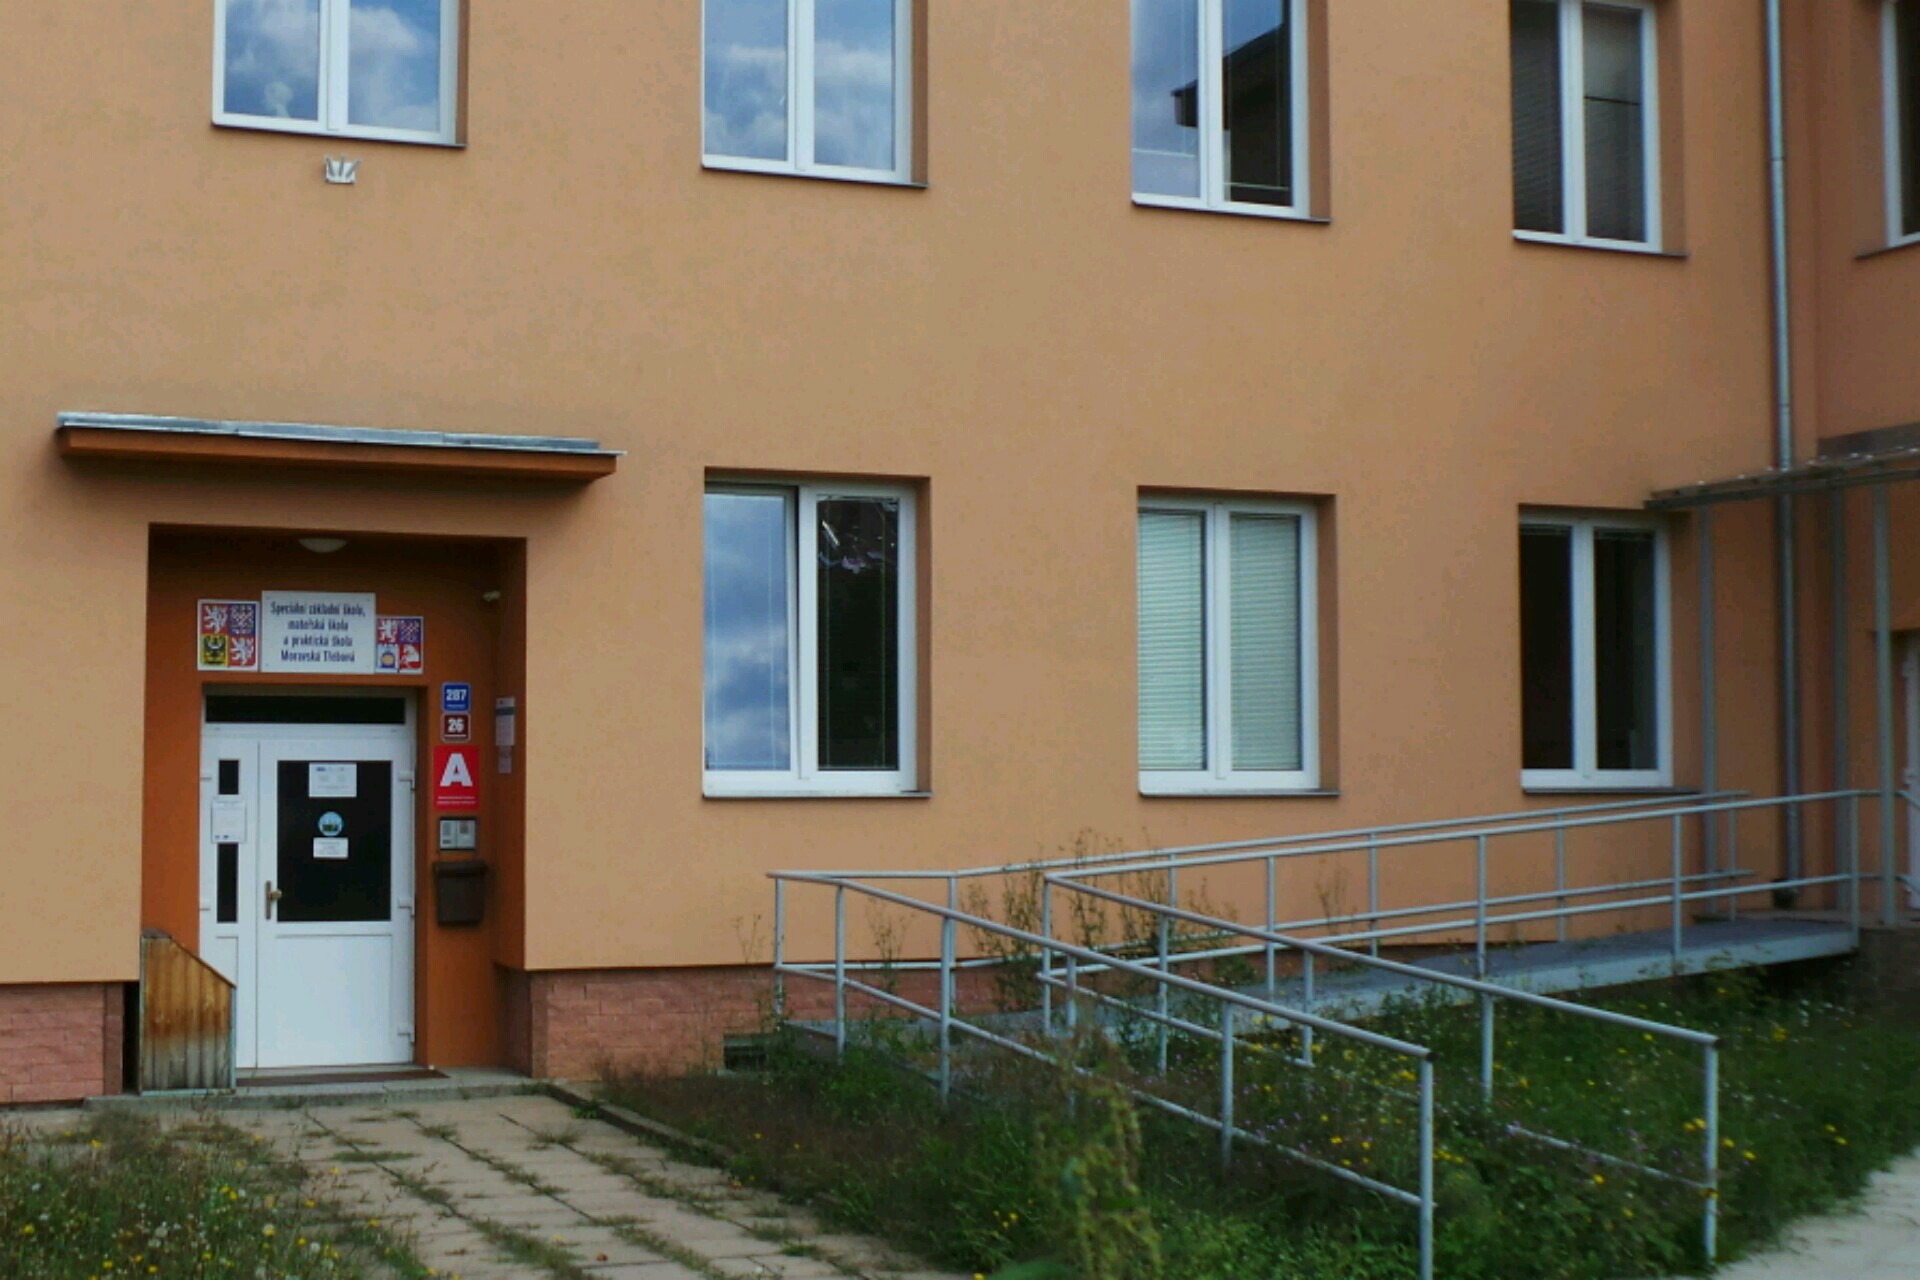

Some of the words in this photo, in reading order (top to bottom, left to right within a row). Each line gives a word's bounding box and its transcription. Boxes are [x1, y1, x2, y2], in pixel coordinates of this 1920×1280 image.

[309, 602, 340, 615] základní
[288, 618, 325, 630] mateřská
[328, 618, 349, 631] škola
[291, 634, 329, 648] praktická
[332, 635, 353, 647] škola
[281, 649, 320, 662] Moravská
[324, 650, 355, 662] Třebová
[446, 688, 467, 701] 287
[448, 718, 464, 733] 26
[440, 753, 473, 787] A
